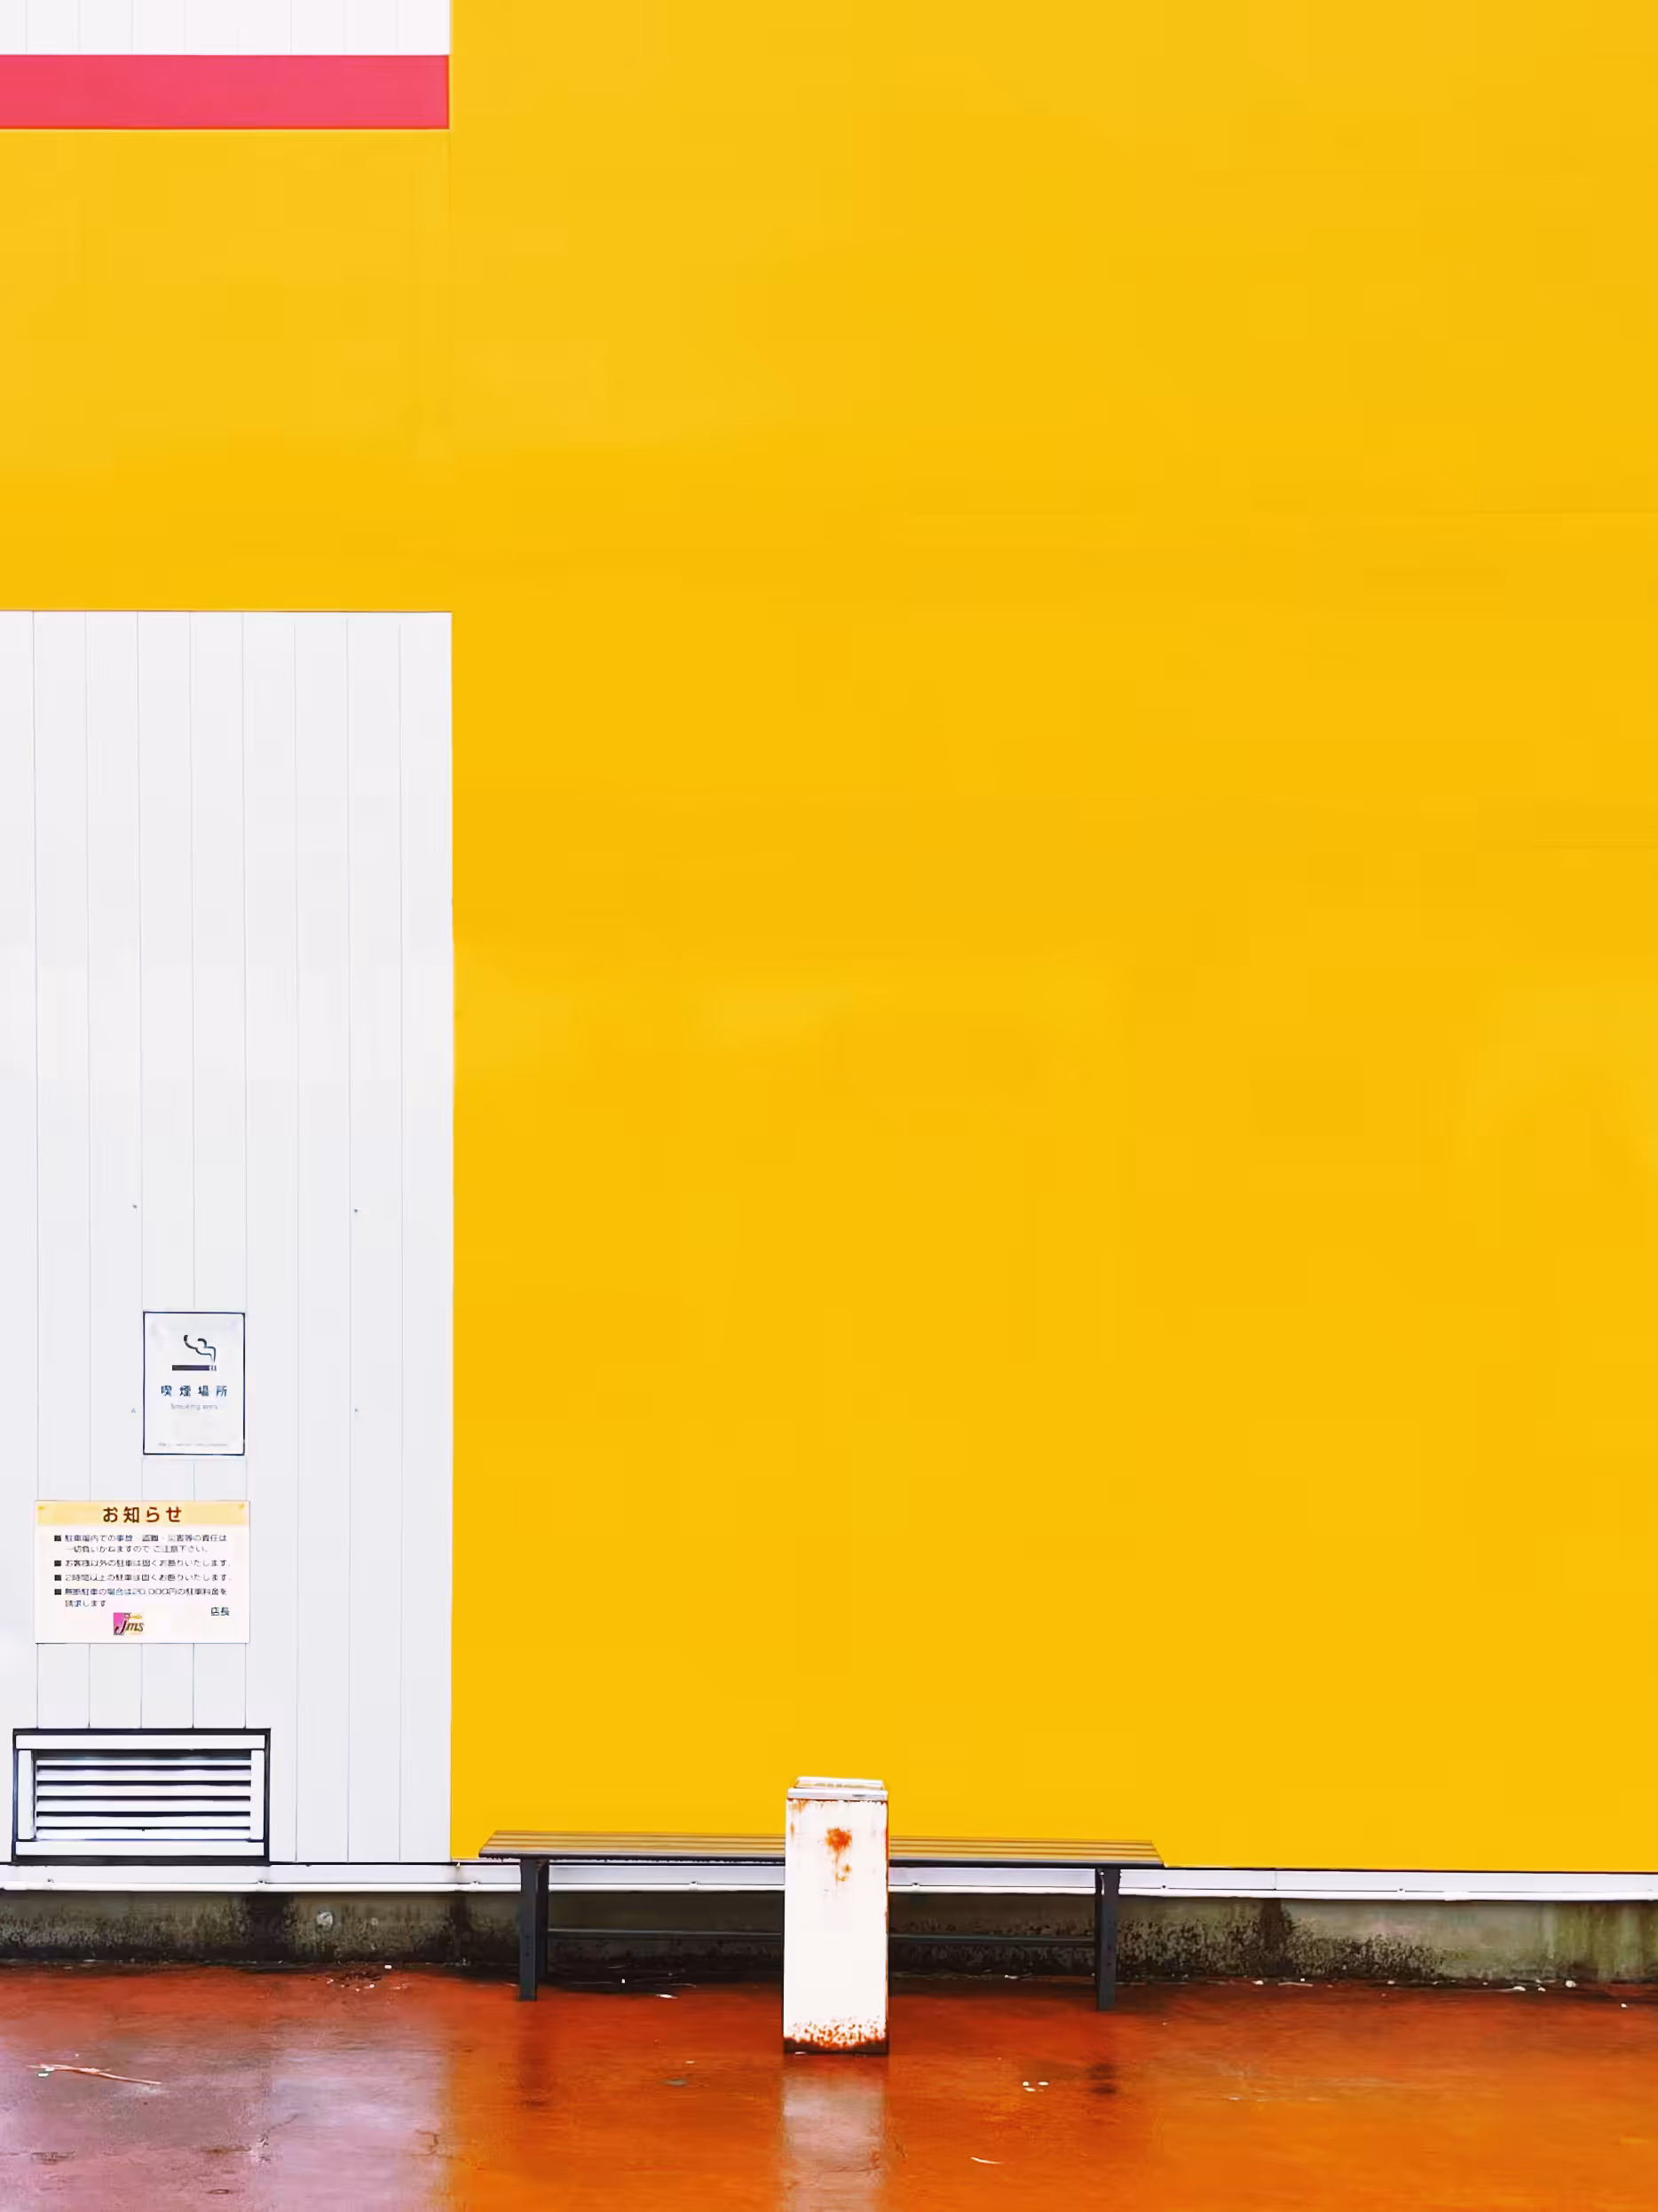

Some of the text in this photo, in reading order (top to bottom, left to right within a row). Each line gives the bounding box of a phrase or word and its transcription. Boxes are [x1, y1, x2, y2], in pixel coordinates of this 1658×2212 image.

[161, 1385, 228, 1397] 喫煙場所
[102, 1505, 183, 1524] お知らせ
[210, 1607, 230, 1616] 店長
